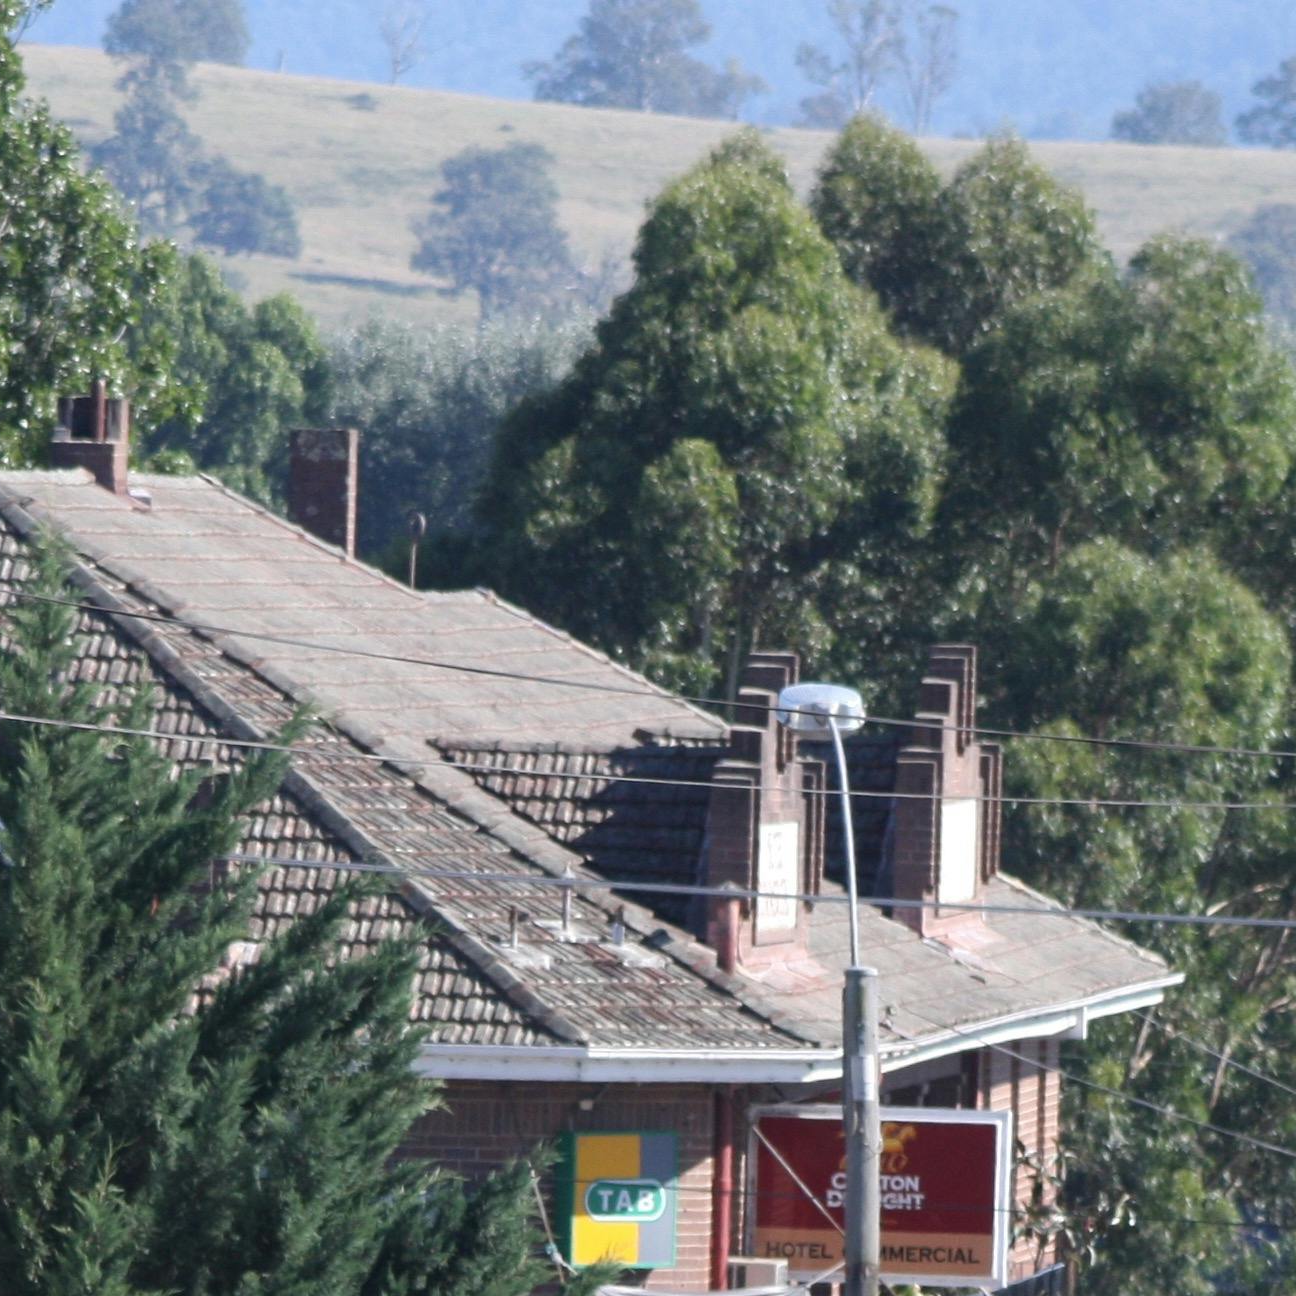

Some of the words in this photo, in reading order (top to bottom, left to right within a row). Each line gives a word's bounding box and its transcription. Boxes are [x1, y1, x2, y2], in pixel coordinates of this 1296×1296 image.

[830, 1172, 920, 1192] CTON
[597, 1189, 655, 1212] TAB
[826, 1190, 926, 1210] DGHT
[765, 1241, 834, 1260] HOTEL
[842, 1244, 981, 1265] MERCIAL
